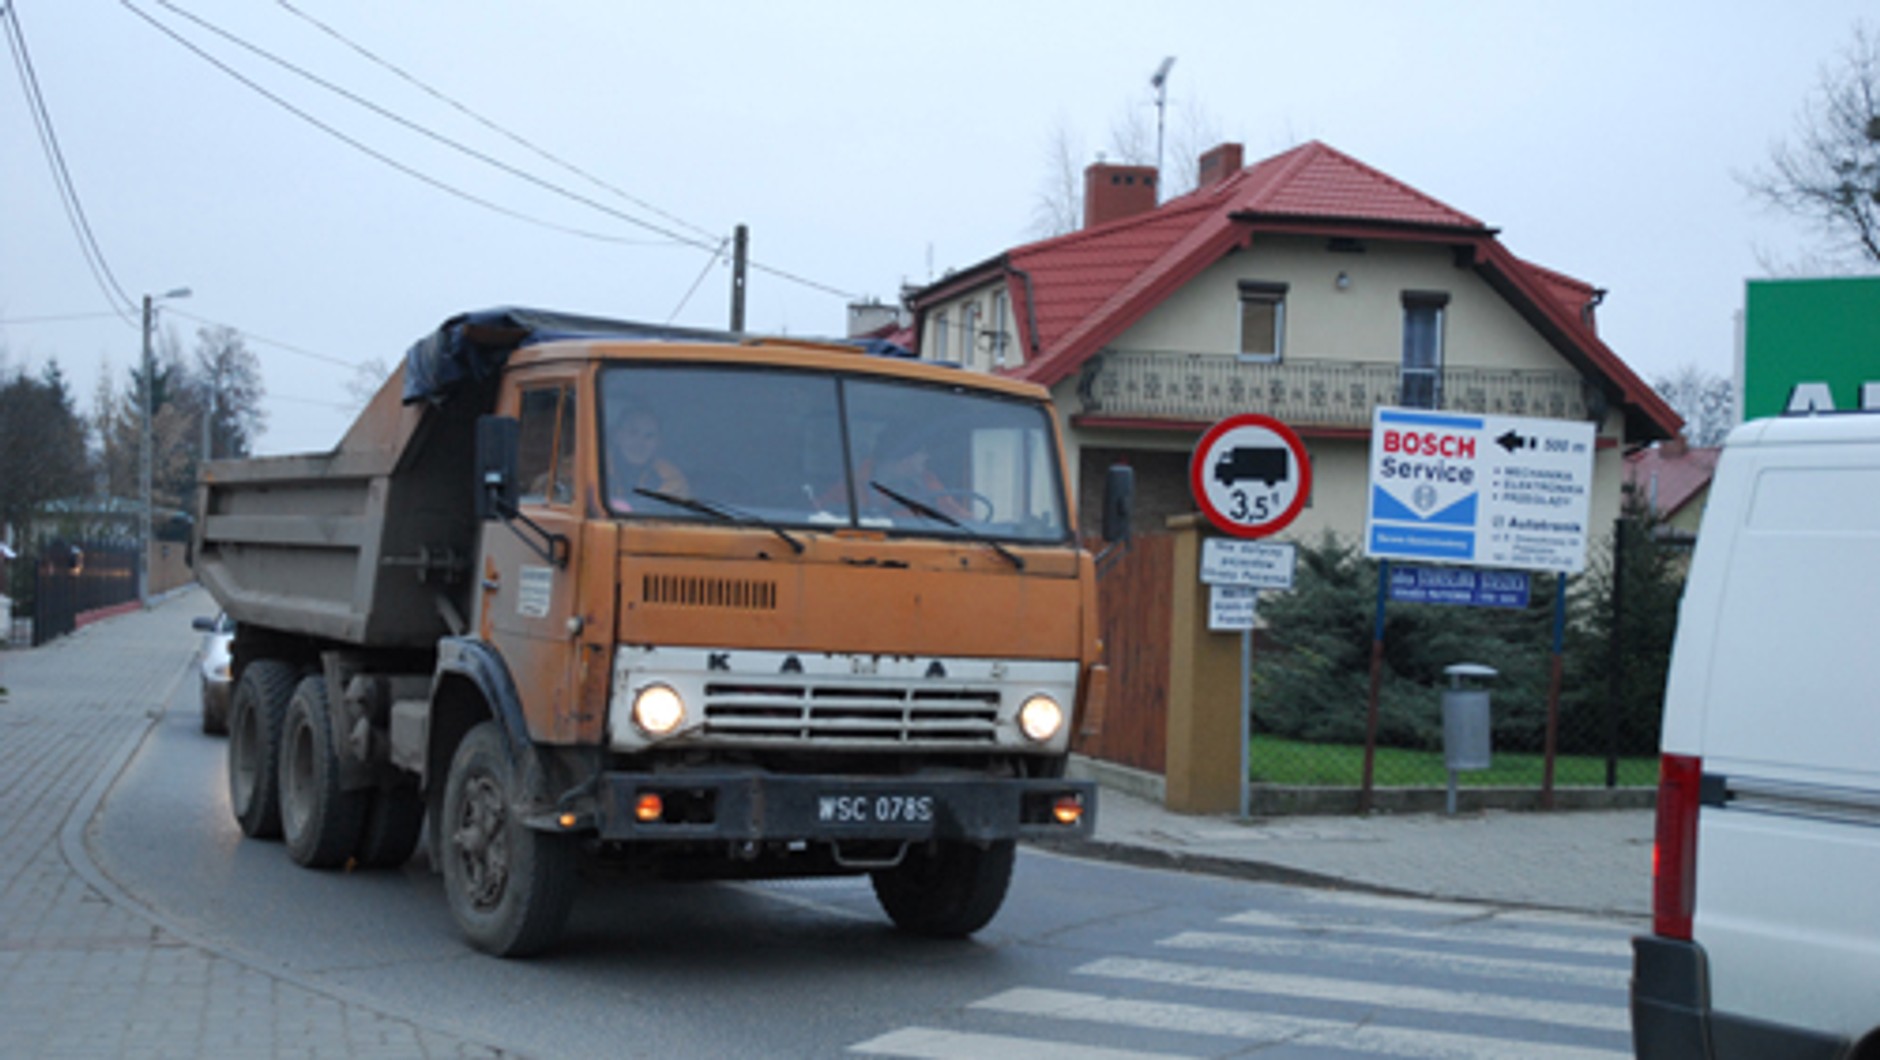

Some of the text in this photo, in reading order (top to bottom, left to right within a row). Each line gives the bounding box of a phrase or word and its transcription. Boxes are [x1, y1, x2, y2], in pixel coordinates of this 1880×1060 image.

[1382, 430, 1476, 459] BOSCH
[1380, 455, 1475, 485] Service
[818, 796, 868, 821] WSC
